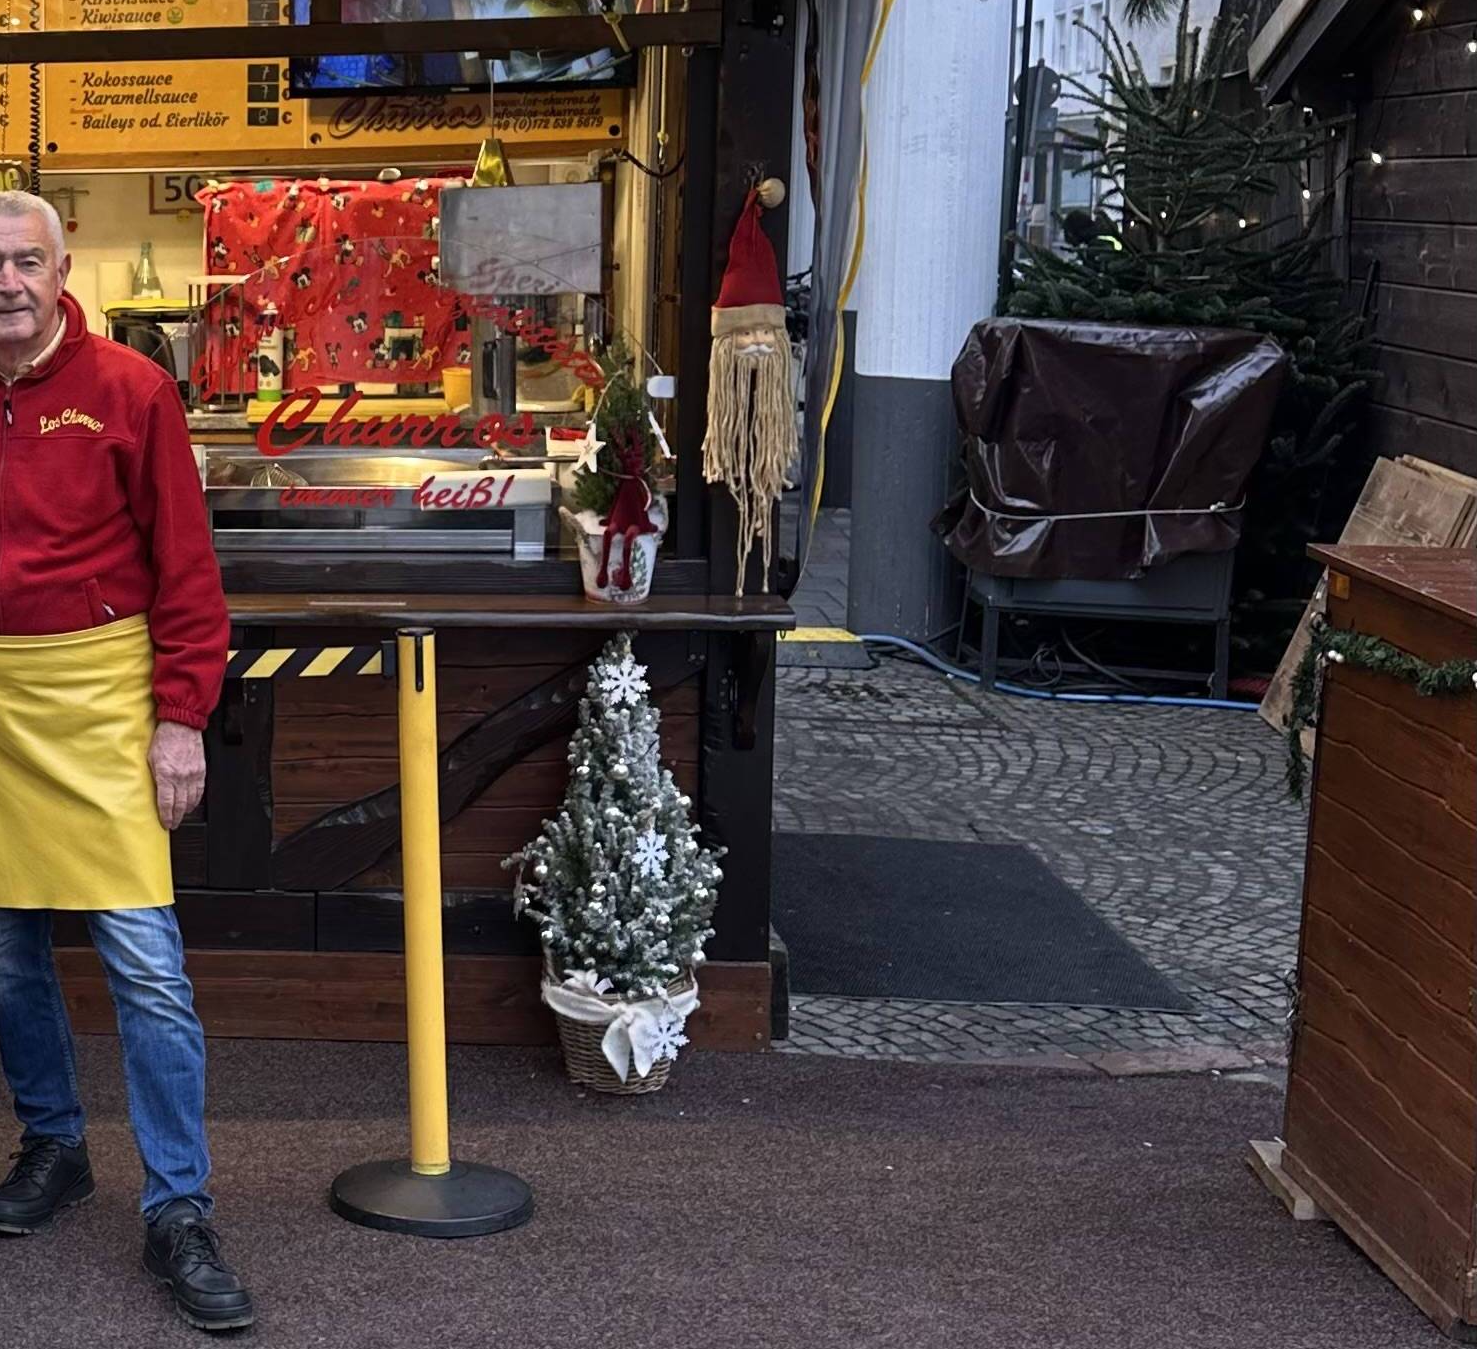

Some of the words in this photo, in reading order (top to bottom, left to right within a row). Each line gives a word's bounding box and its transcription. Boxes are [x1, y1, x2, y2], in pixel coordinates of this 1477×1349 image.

[81, 9, 162, 25] Kiwisauce
[81, 70, 173, 88] Kokossauce
[81, 88, 199, 106] Karamellsauce
[82, 114, 135, 133] Baileys
[139, 112, 162, 128] od.
[165, 110, 230, 127] Eierlikör
[328, 95, 484, 140] Churros
[39, 415, 62, 435] Los
[61, 407, 105, 434] Churros
[255, 386, 541, 456] Churros
[279, 483, 397, 509] immer
[413, 475, 515, 511] heiß!
